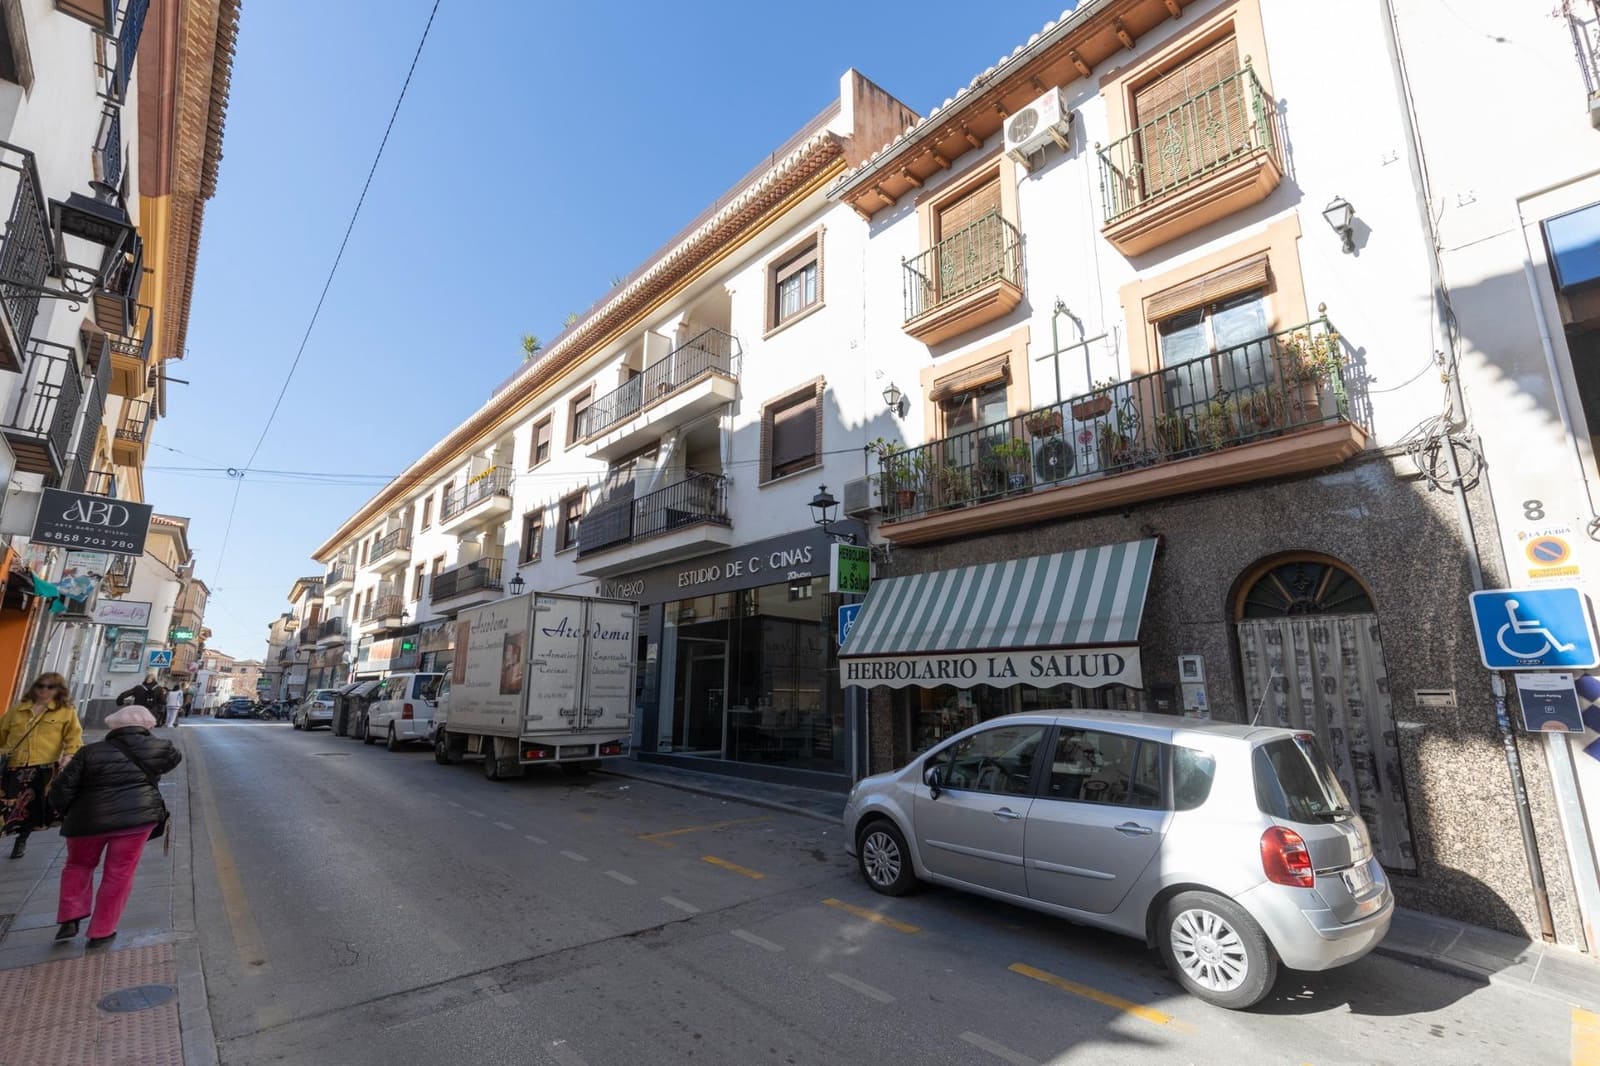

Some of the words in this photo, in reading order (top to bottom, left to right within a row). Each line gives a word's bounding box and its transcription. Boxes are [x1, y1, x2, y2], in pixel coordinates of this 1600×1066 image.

[62, 500, 129, 528] ABD
[1523, 499, 1545, 521] 8
[54, 532, 79, 542] 858
[84, 536, 106, 545] 701
[111, 540, 134, 549] 780
[678, 565, 721, 587] ESTUDIO
[726, 561, 743, 578] DE
[847, 658, 977, 681] HERBOLARIO
[988, 656, 1018, 677] LA
[1030, 653, 1125, 677] SALUD
